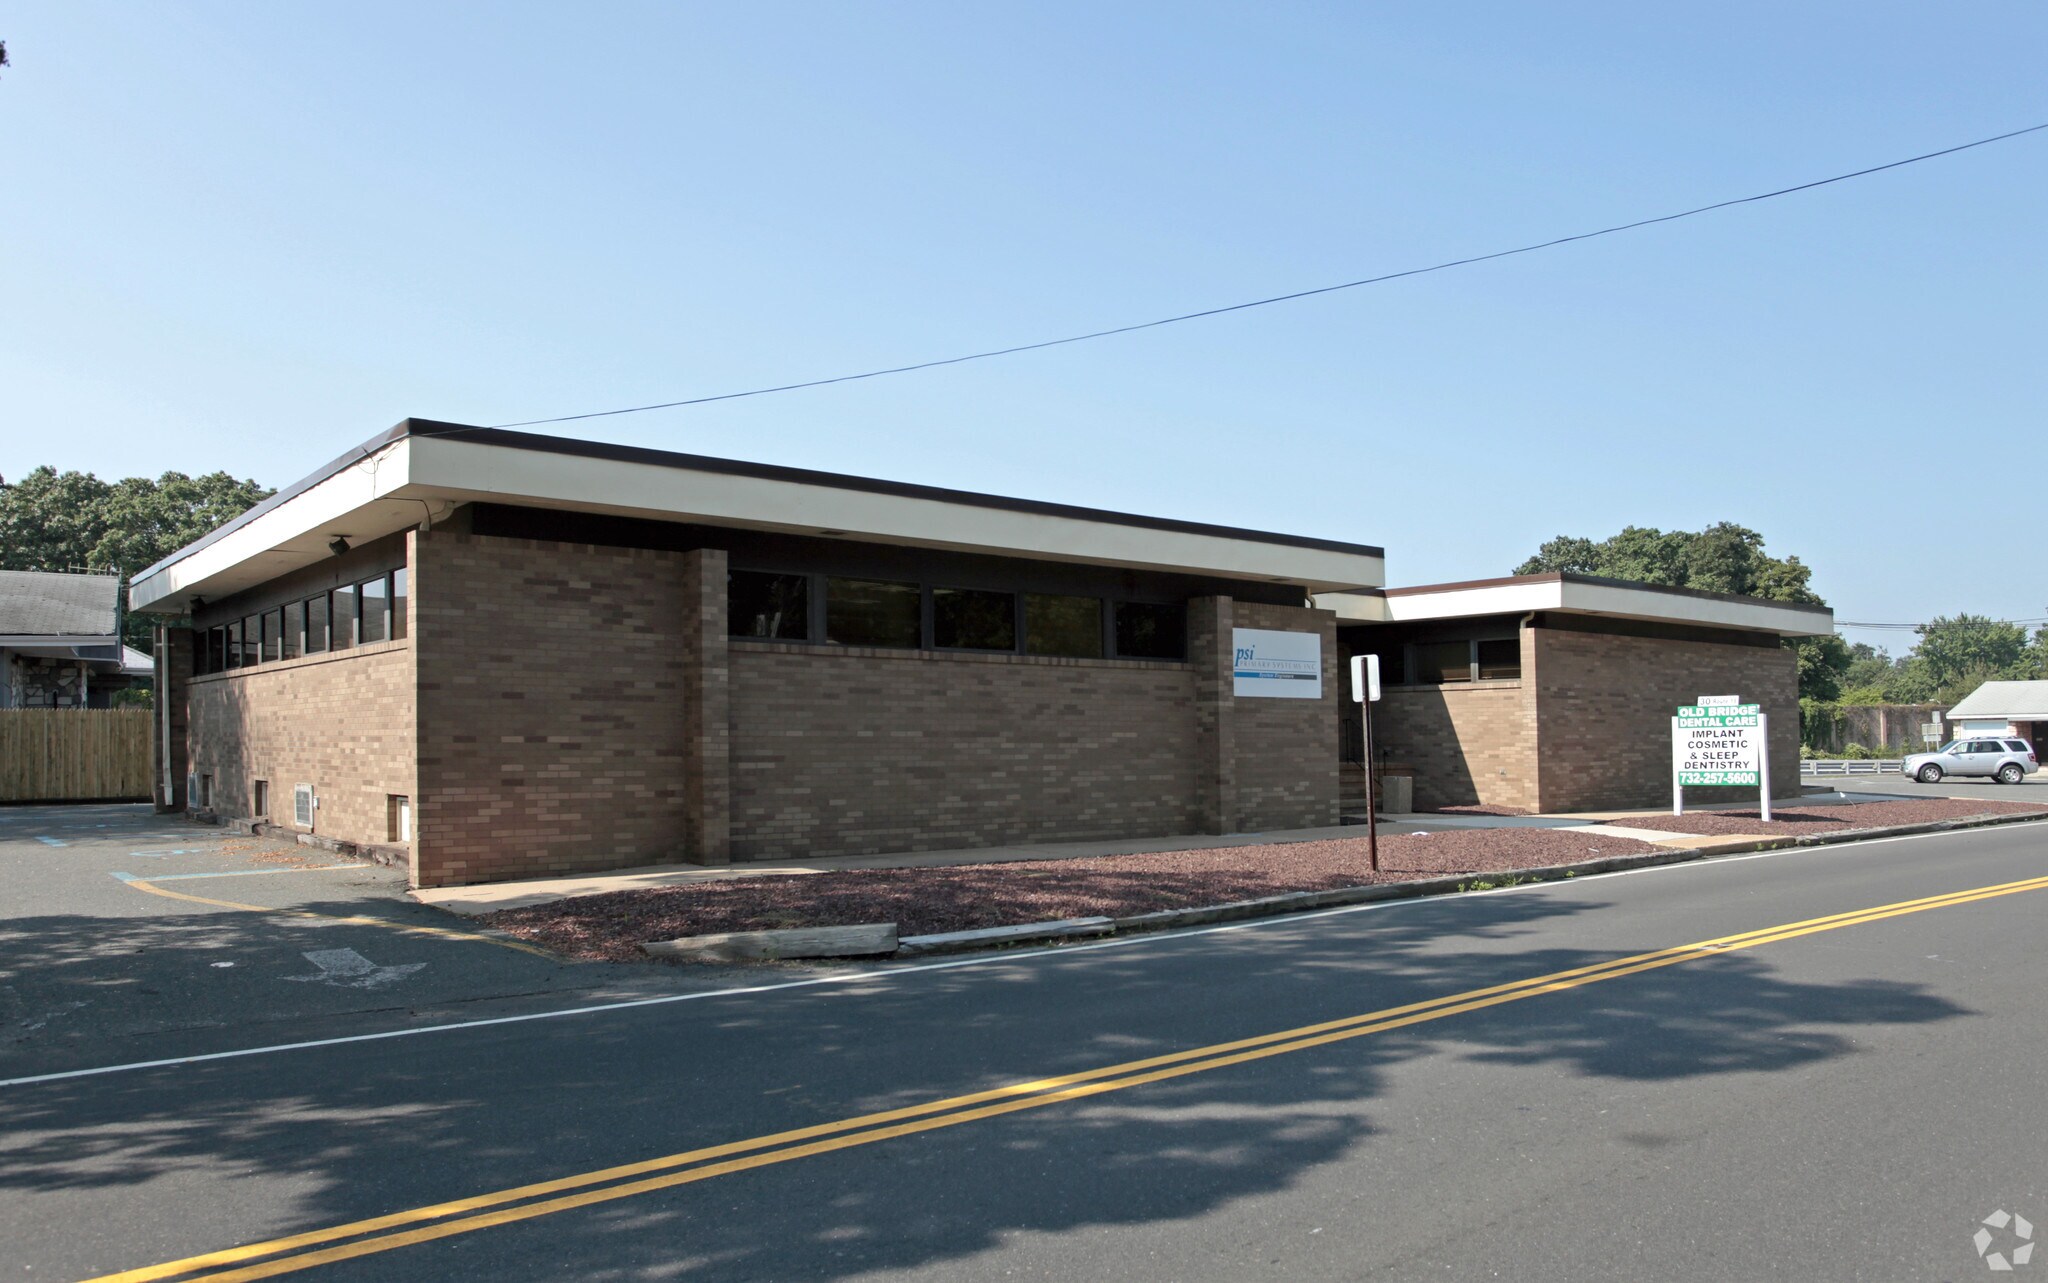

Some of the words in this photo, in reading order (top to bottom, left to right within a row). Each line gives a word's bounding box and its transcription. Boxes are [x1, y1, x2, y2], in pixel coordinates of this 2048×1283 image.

[1235, 644, 1255, 667] psi
[1240, 660, 1271, 668] PRIMARY
[1272, 661, 1302, 670] SYSTEMS
[1700, 697, 1711, 706] 30
[1679, 707, 1705, 717] OLD
[1708, 705, 1757, 716] BRIDGE
[1680, 717, 1723, 727] DENTAL
[1725, 716, 1757, 726] CARE
[1692, 729, 1744, 738] IMPLANT
[1687, 740, 1748, 749] COSMETIC
[1690, 752, 1698, 760] &
[1702, 751, 1739, 760] SLEEP
[1684, 761, 1750, 769] DENTISTRY
[1680, 772, 1756, 784] 732-257-5600
